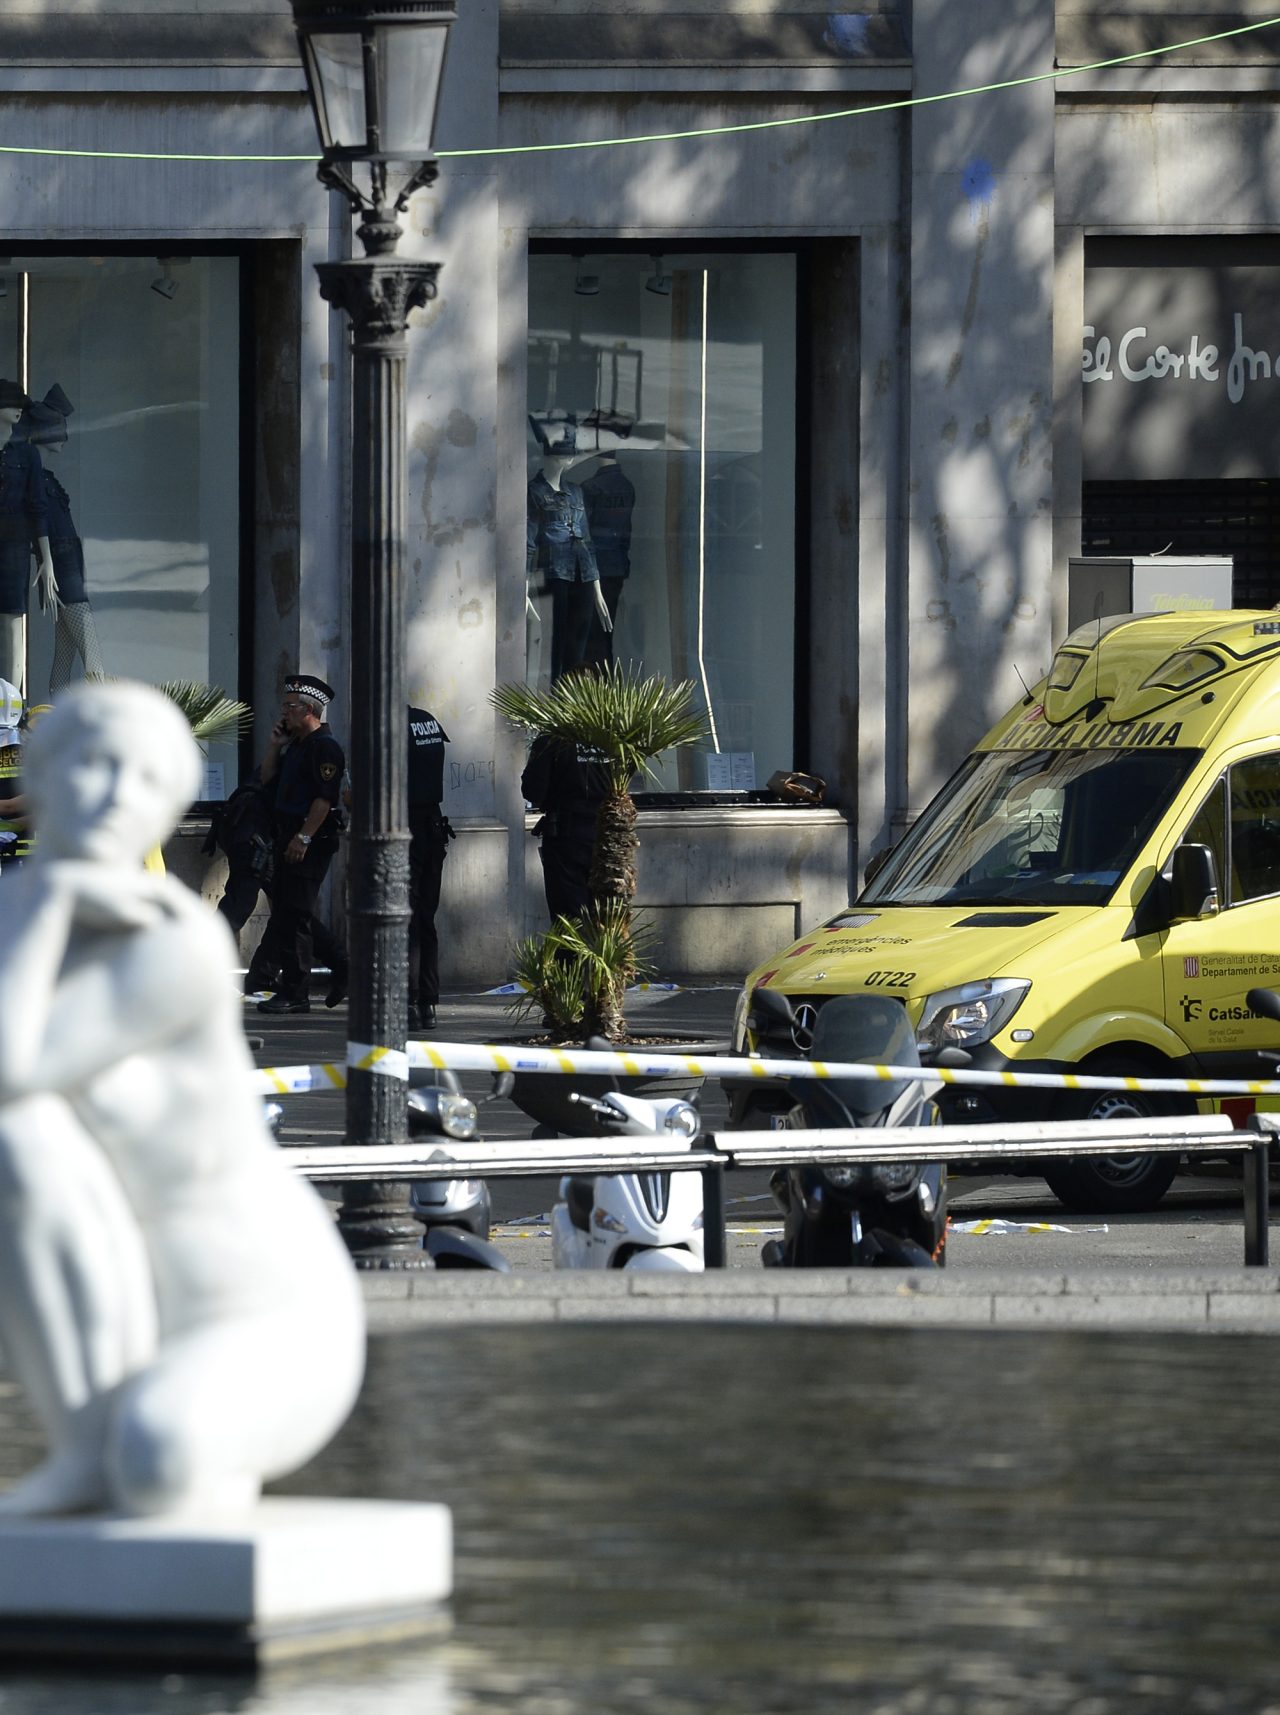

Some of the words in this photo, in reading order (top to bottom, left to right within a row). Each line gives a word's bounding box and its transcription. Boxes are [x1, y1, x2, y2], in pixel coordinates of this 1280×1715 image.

[1118, 327, 1220, 383] Corte
[1226, 312, 1280, 404] In
[410, 720, 440, 737] POLICIA
[1201, 956, 1246, 966] Generalitat
[1247, 955, 1258, 964] de
[1260, 953, 1280, 963] Cata
[864, 971, 917, 988] 0722
[1202, 966, 1257, 978] Departament
[1259, 965, 1270, 974] de
[1272, 964, 1280, 974] Sa
